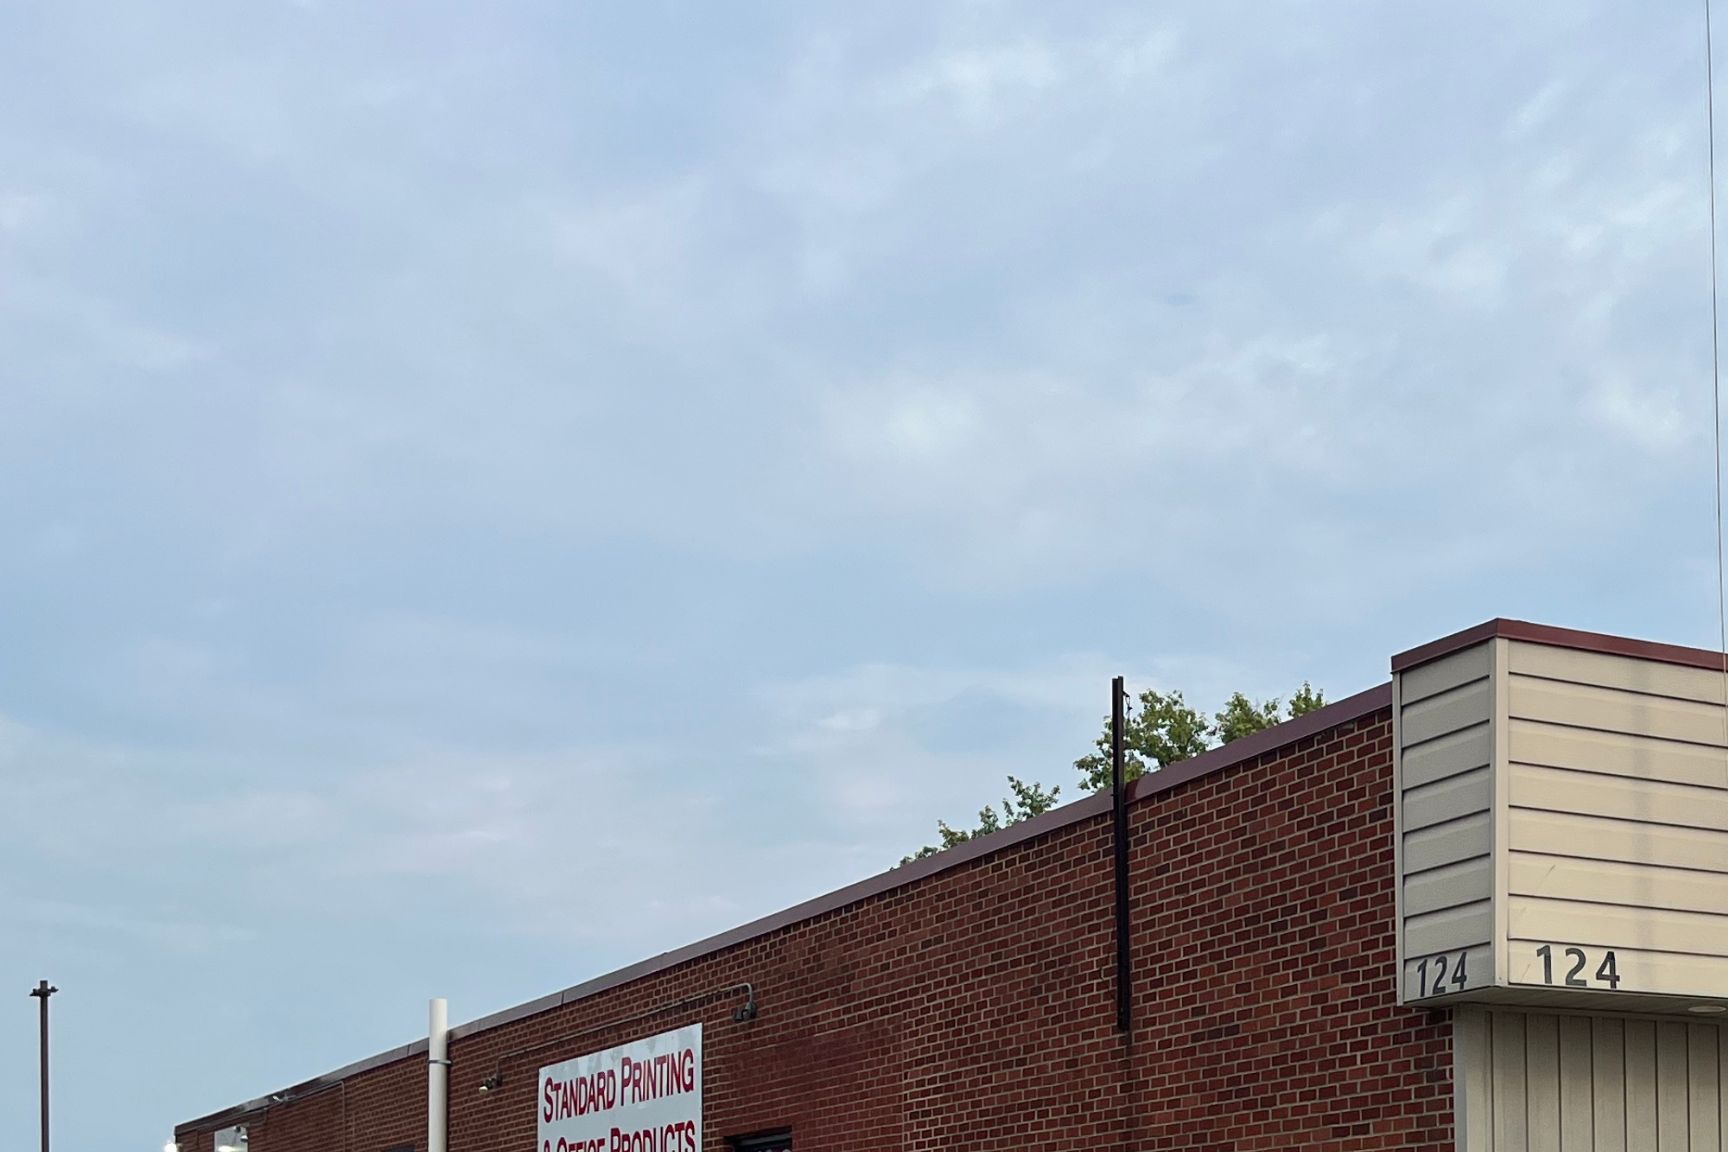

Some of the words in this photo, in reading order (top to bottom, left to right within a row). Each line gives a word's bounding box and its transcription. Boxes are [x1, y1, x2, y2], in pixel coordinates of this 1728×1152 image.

[1417, 951, 1467, 997] 124
[1536, 944, 1620, 989] 124
[543, 1071, 616, 1123] STANDARD
[620, 1048, 694, 1106] PRINTING
